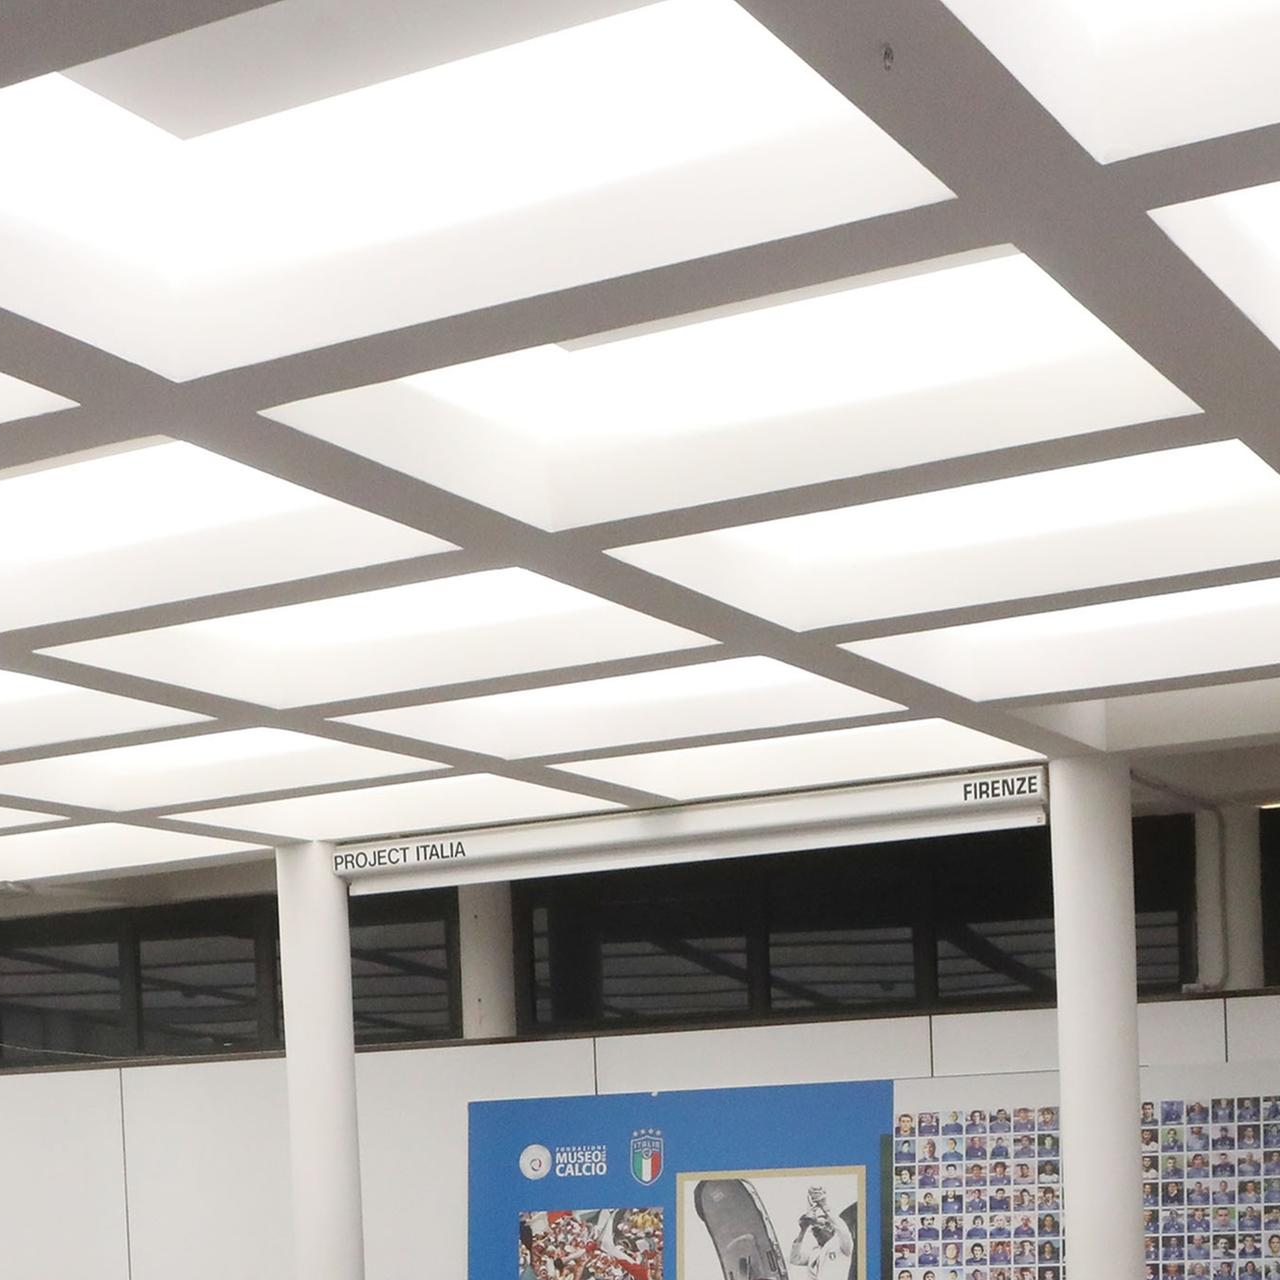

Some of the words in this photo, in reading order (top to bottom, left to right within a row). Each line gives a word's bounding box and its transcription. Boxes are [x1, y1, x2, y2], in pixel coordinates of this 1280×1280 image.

[963, 775, 1038, 801] FIRENZE
[333, 846, 410, 871] PROJECT
[415, 841, 466, 861] ITALIA
[556, 1144, 606, 1152] FONDAZIONE
[556, 1150, 601, 1164] MUSEO
[555, 1162, 607, 1177] CALCIO
